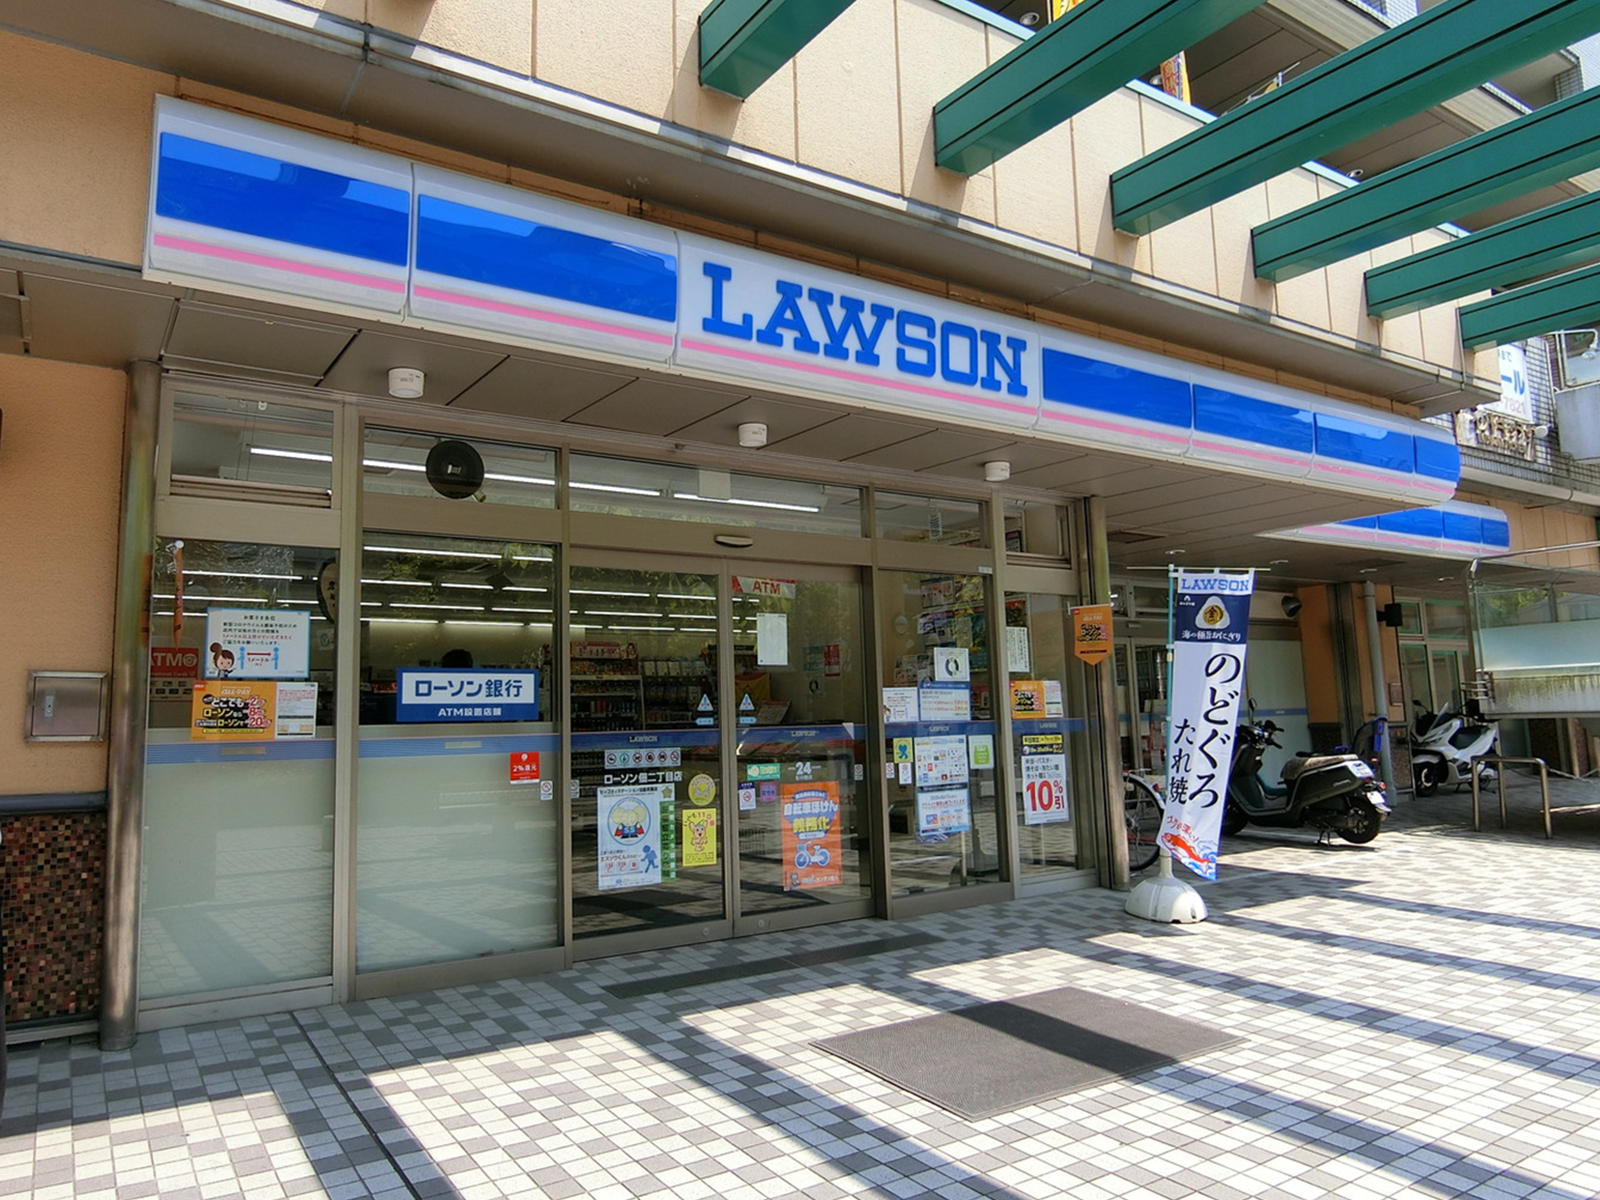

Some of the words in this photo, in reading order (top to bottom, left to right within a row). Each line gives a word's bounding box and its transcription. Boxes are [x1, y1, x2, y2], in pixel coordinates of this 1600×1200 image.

[702, 262, 1028, 397] LAWSON
[753, 580, 781, 595] ATM
[1181, 578, 1250, 591] LAWSON
[415, 679, 523, 698] ローソン銀行
[438, 707, 501, 717] ATM設置店舗
[1189, 653, 1241, 808] のどぐろ
[796, 761, 811, 775] 24
[1170, 718, 1196, 805] たれ焼
[784, 800, 838, 816] 自転車ほけん
[793, 817, 830, 833] 義務化
